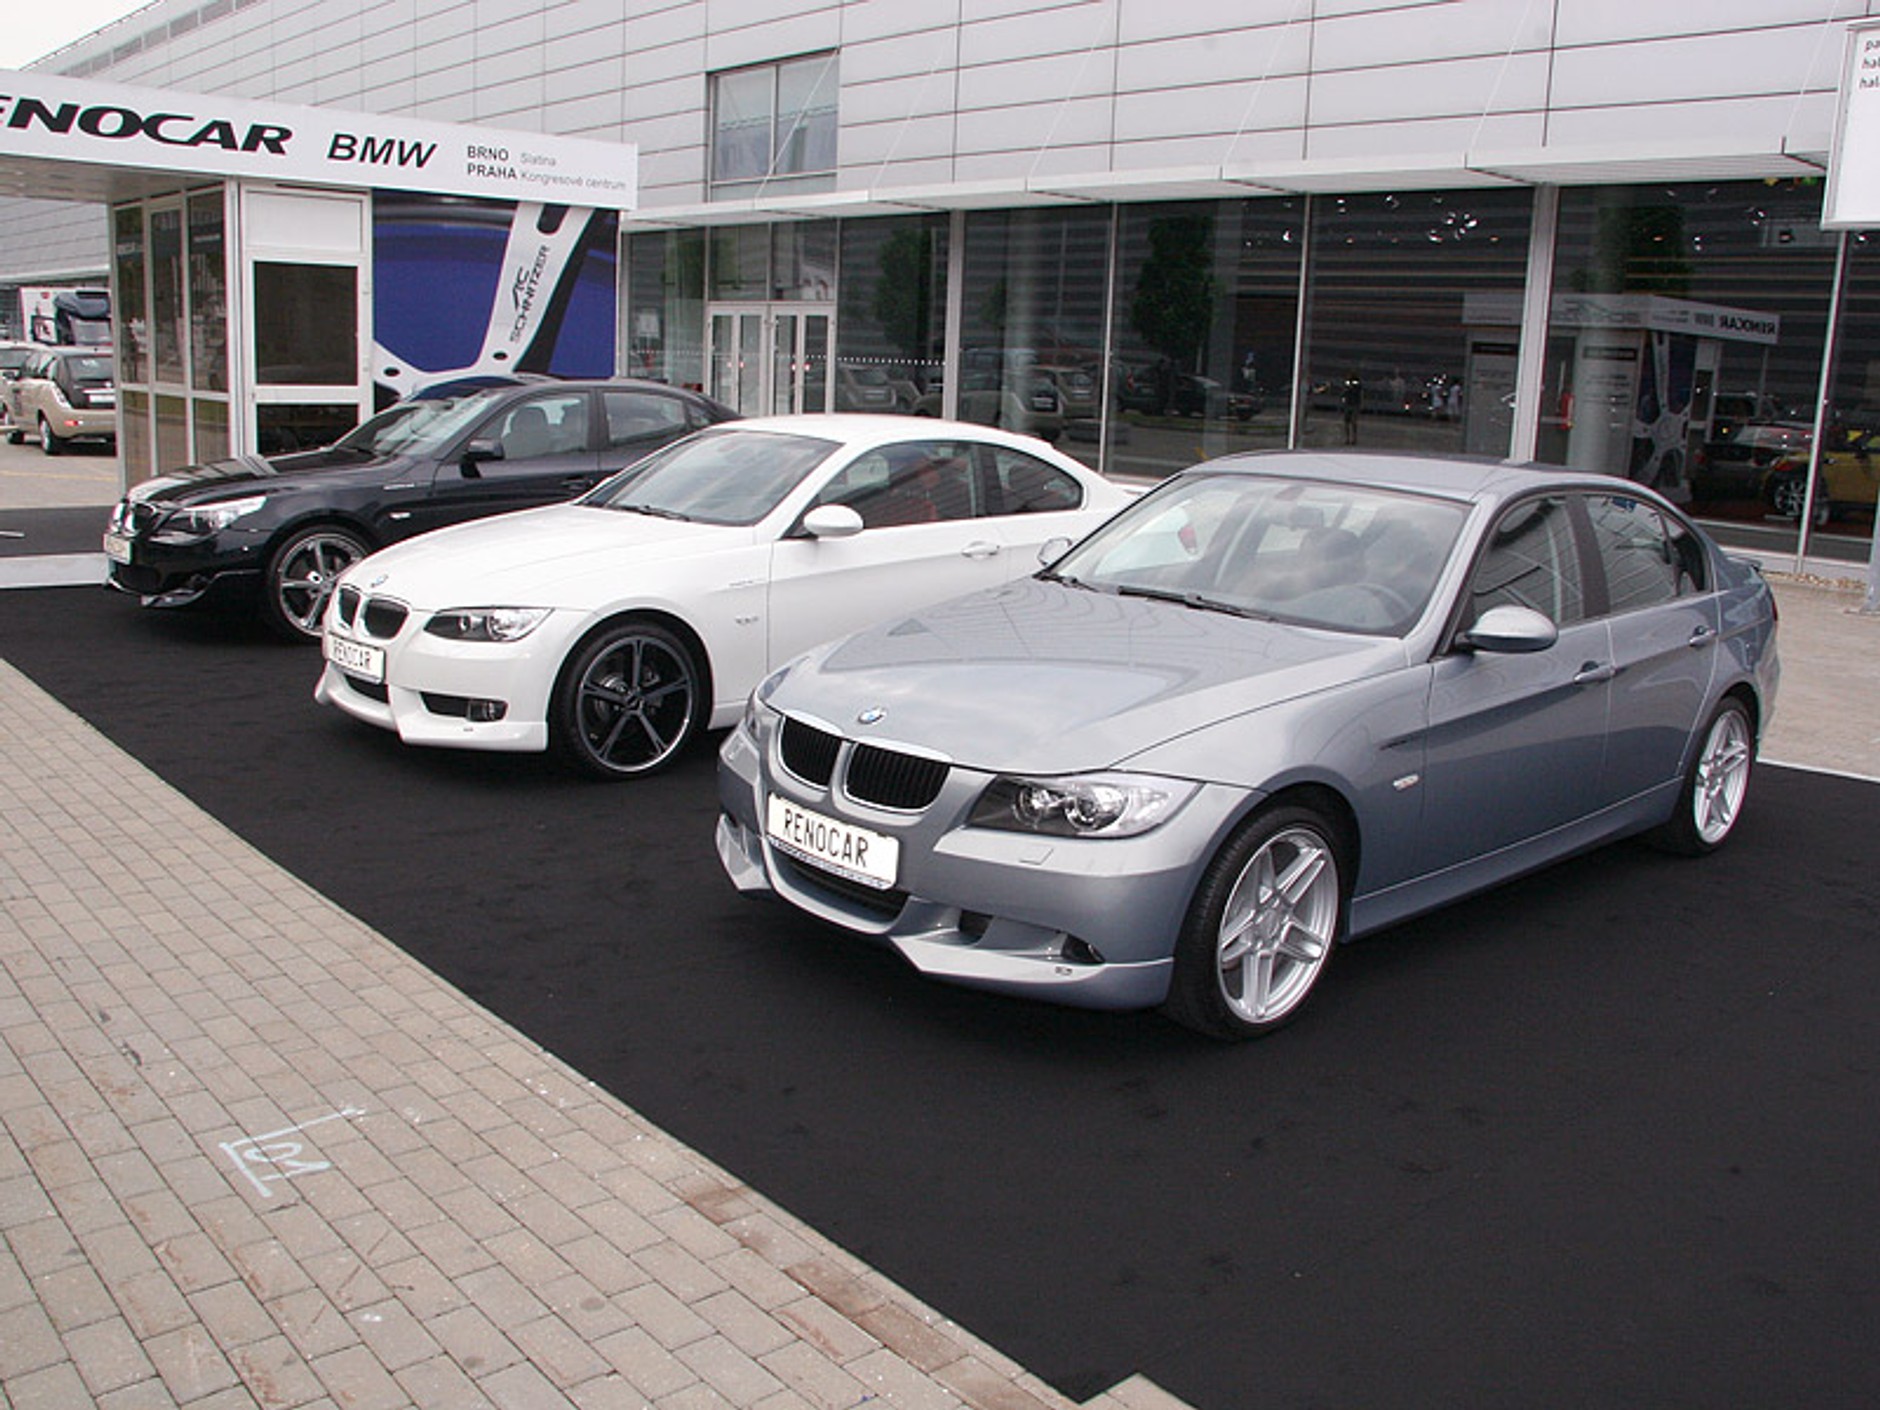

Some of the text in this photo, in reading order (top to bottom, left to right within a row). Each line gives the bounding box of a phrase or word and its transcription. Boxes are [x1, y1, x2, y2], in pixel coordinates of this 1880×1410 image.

[0, 95, 437, 168] NOCAR BMW
[467, 145, 556, 166] BRNO Slatina
[467, 162, 518, 180] PRAHA
[585, 178, 627, 190] centrum
[509, 245, 551, 343] SCHNITZER
[783, 807, 870, 868] RENOCAR
